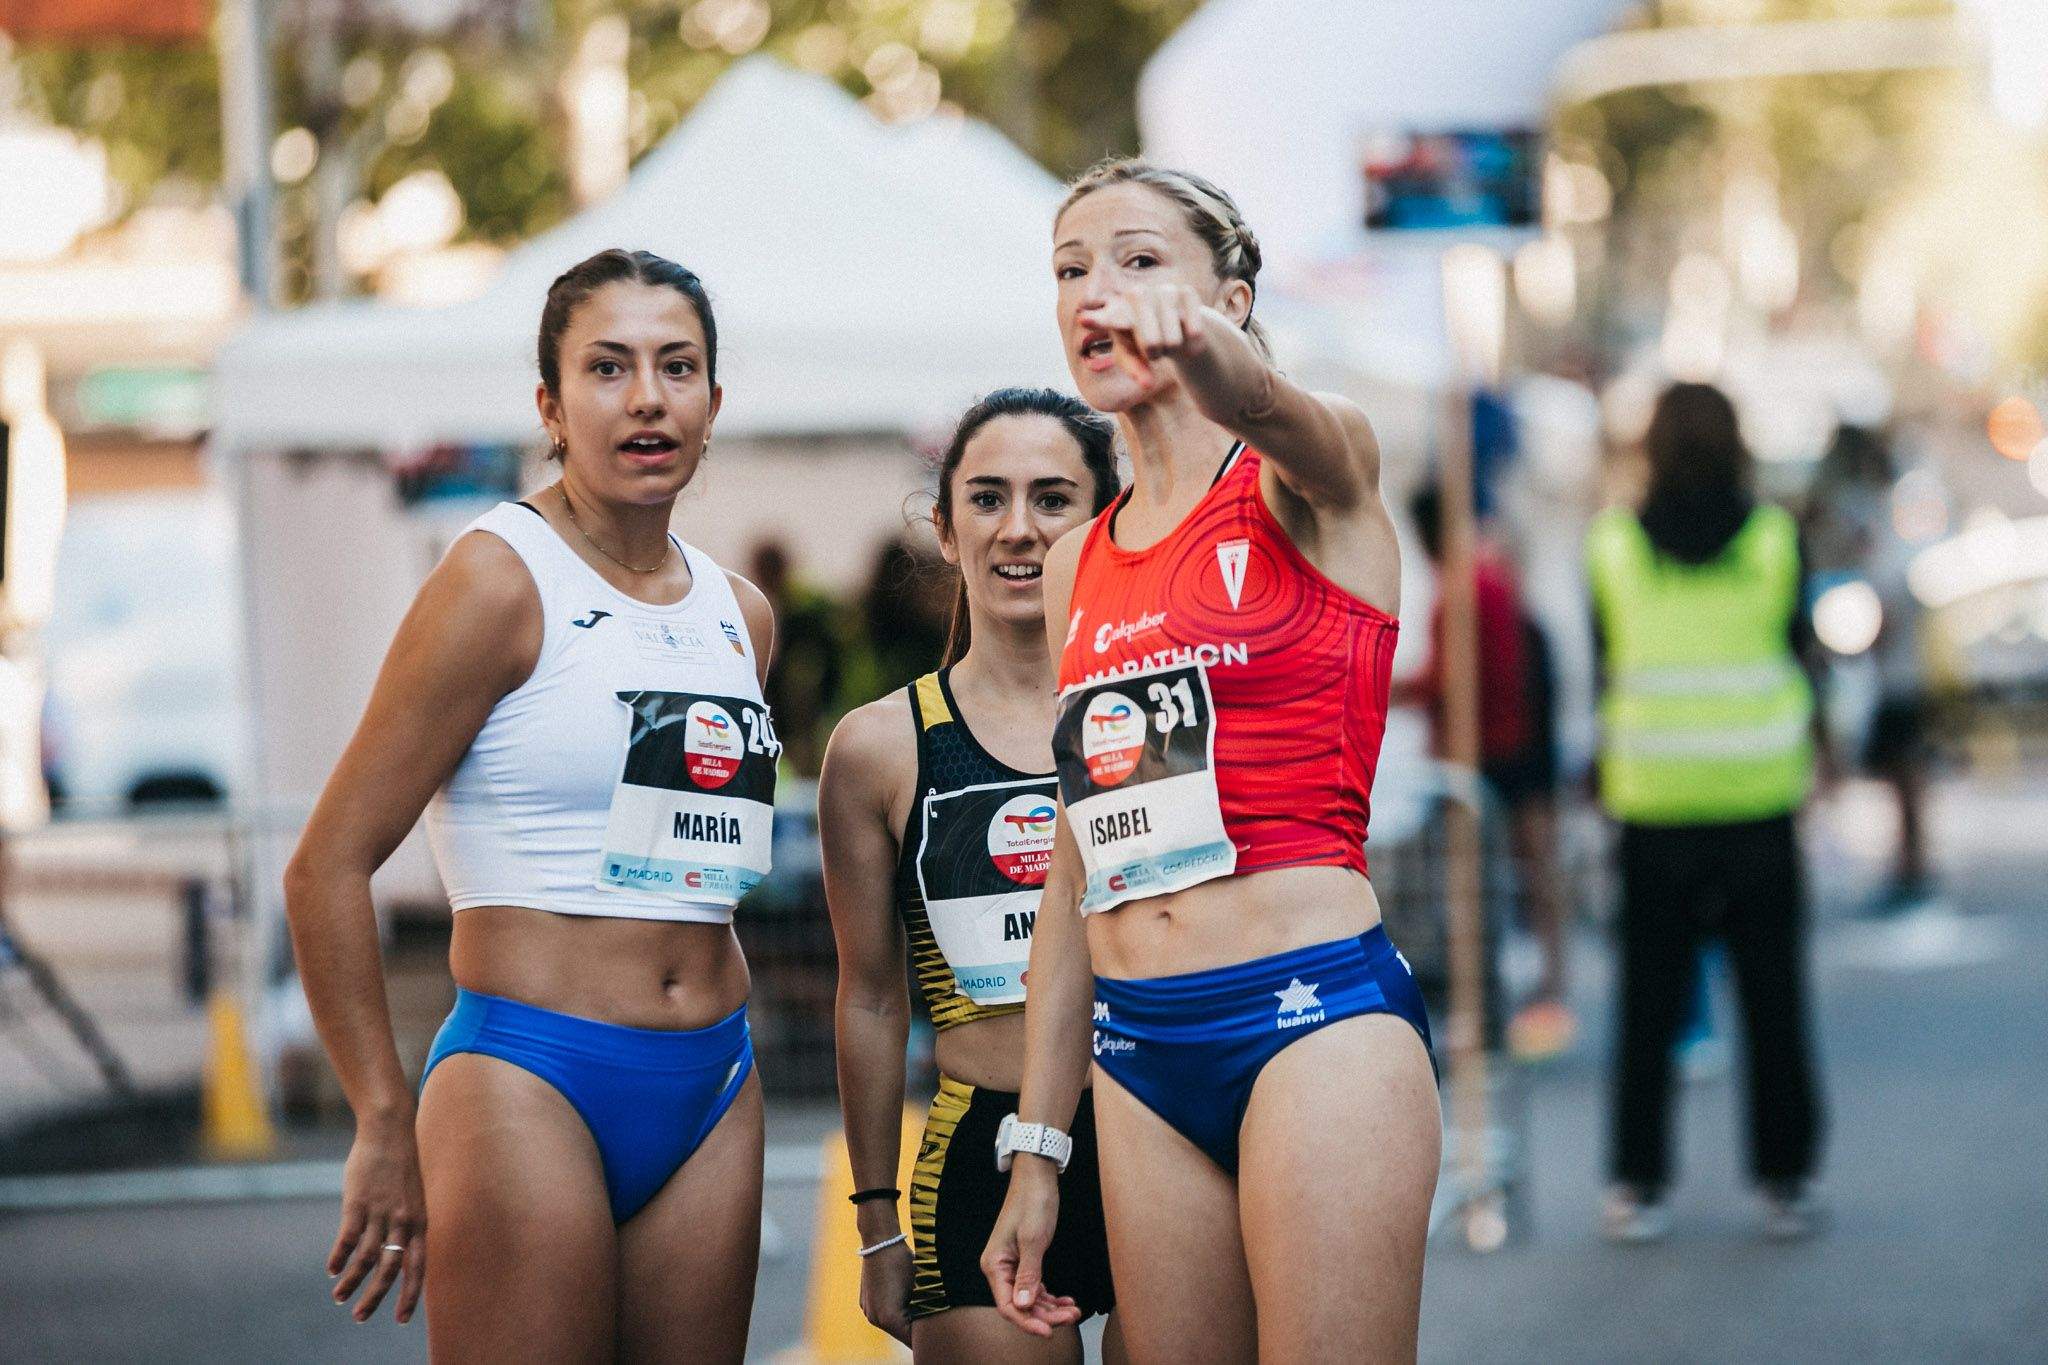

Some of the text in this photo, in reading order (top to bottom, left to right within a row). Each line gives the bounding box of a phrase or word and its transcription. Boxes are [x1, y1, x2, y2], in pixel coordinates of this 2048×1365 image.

[1147, 678, 1198, 734] 31
[673, 811, 742, 845] MARÍA
[1089, 806, 1152, 847] ISABEL
[1006, 838, 1055, 848] TotalEnergie
[1020, 852, 1050, 864] MILLA
[626, 868, 673, 883] MADRID
[1009, 865, 1024, 875] DE
[1004, 911, 1036, 942] AN
[962, 976, 1006, 989] MADRID
[1276, 1009, 1325, 1030] luanvi
